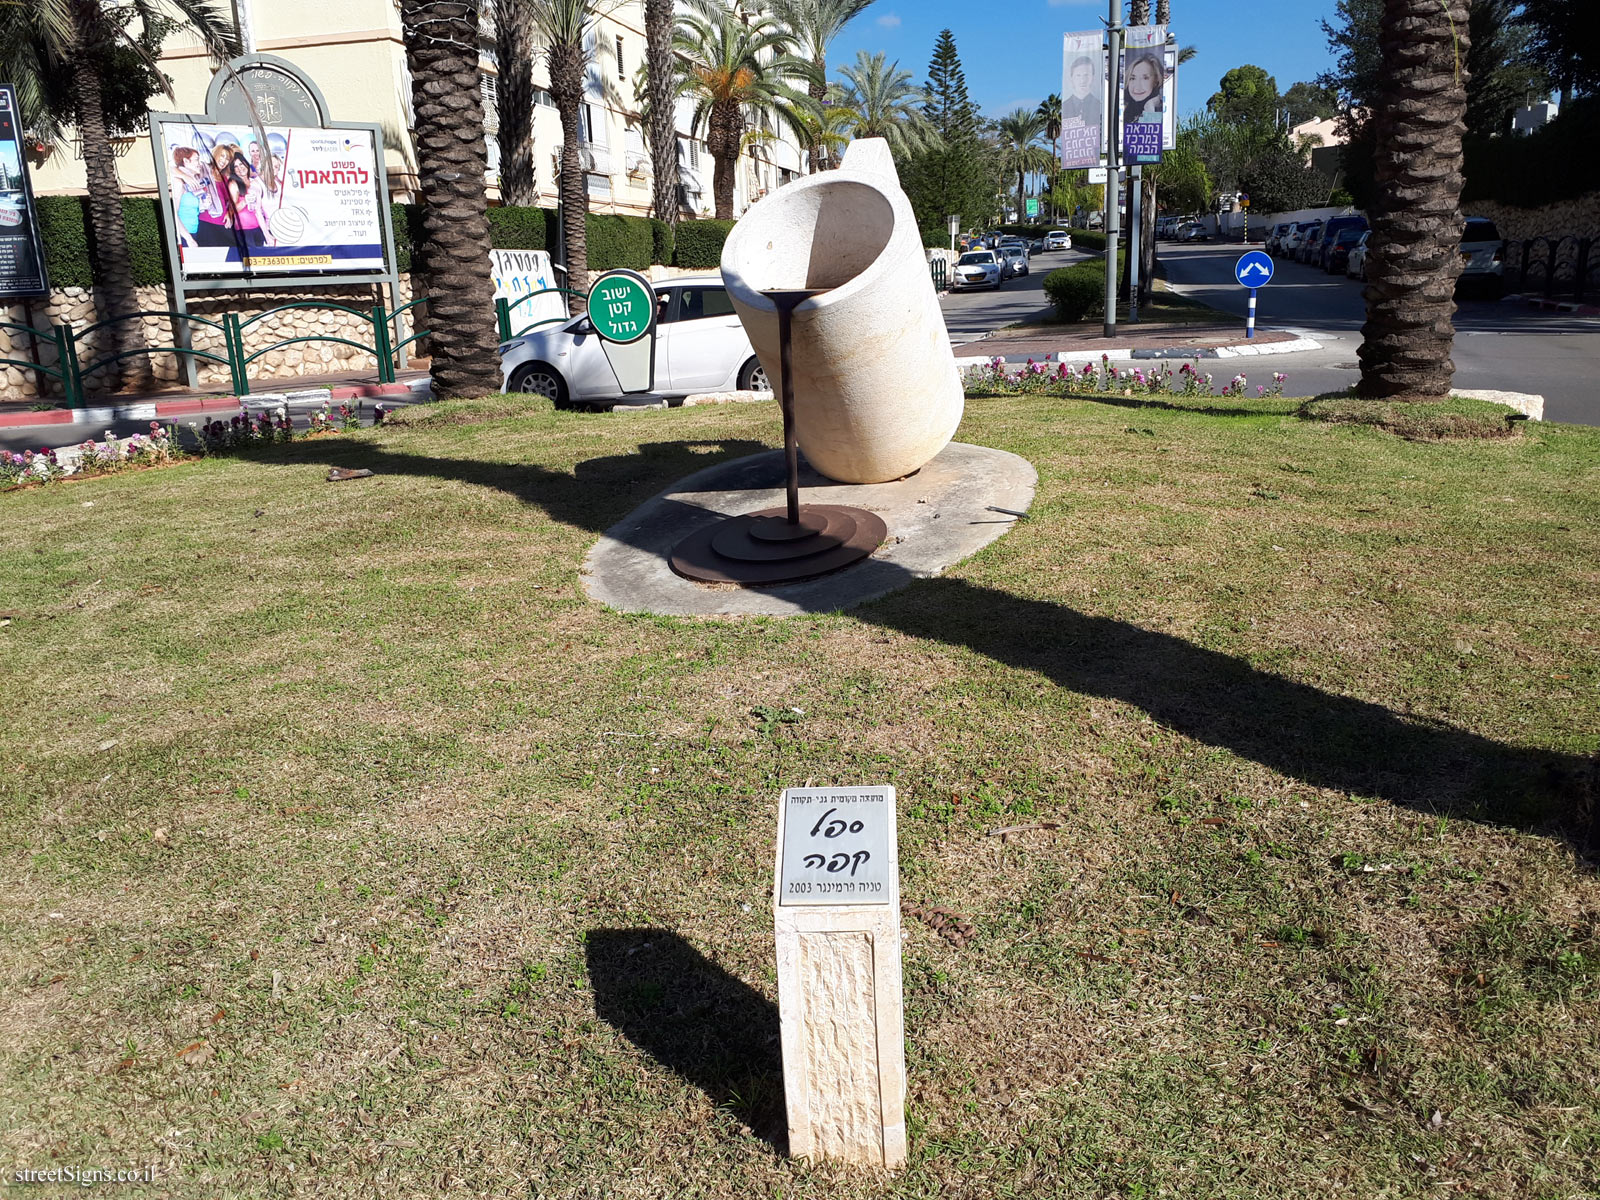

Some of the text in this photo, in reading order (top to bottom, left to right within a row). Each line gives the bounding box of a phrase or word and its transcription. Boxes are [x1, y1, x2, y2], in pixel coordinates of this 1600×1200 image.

[278, 77, 301, 94] תקווה
[298, 95, 311, 109] גני
[1126, 124, 1160, 134] נתראה
[1126, 134, 1159, 144] במרכז
[1129, 145, 1158, 154] הבמה
[331, 160, 356, 169] פשוט
[297, 167, 369, 189] להתאמן
[351, 208, 365, 216] TRX
[248, 256, 328, 266] לפרטים: 03-7363011
[601, 286, 631, 301] ישוב
[608, 301, 632, 318] קטן
[608, 320, 638, 334] גדול
[830, 795, 857, 804] מקומית
[859, 794, 884, 802] מועצה
[810, 808, 864, 838] ספל
[803, 850, 871, 877] קפה
[789, 882, 882, 893] טניה פרמינגר 2003
